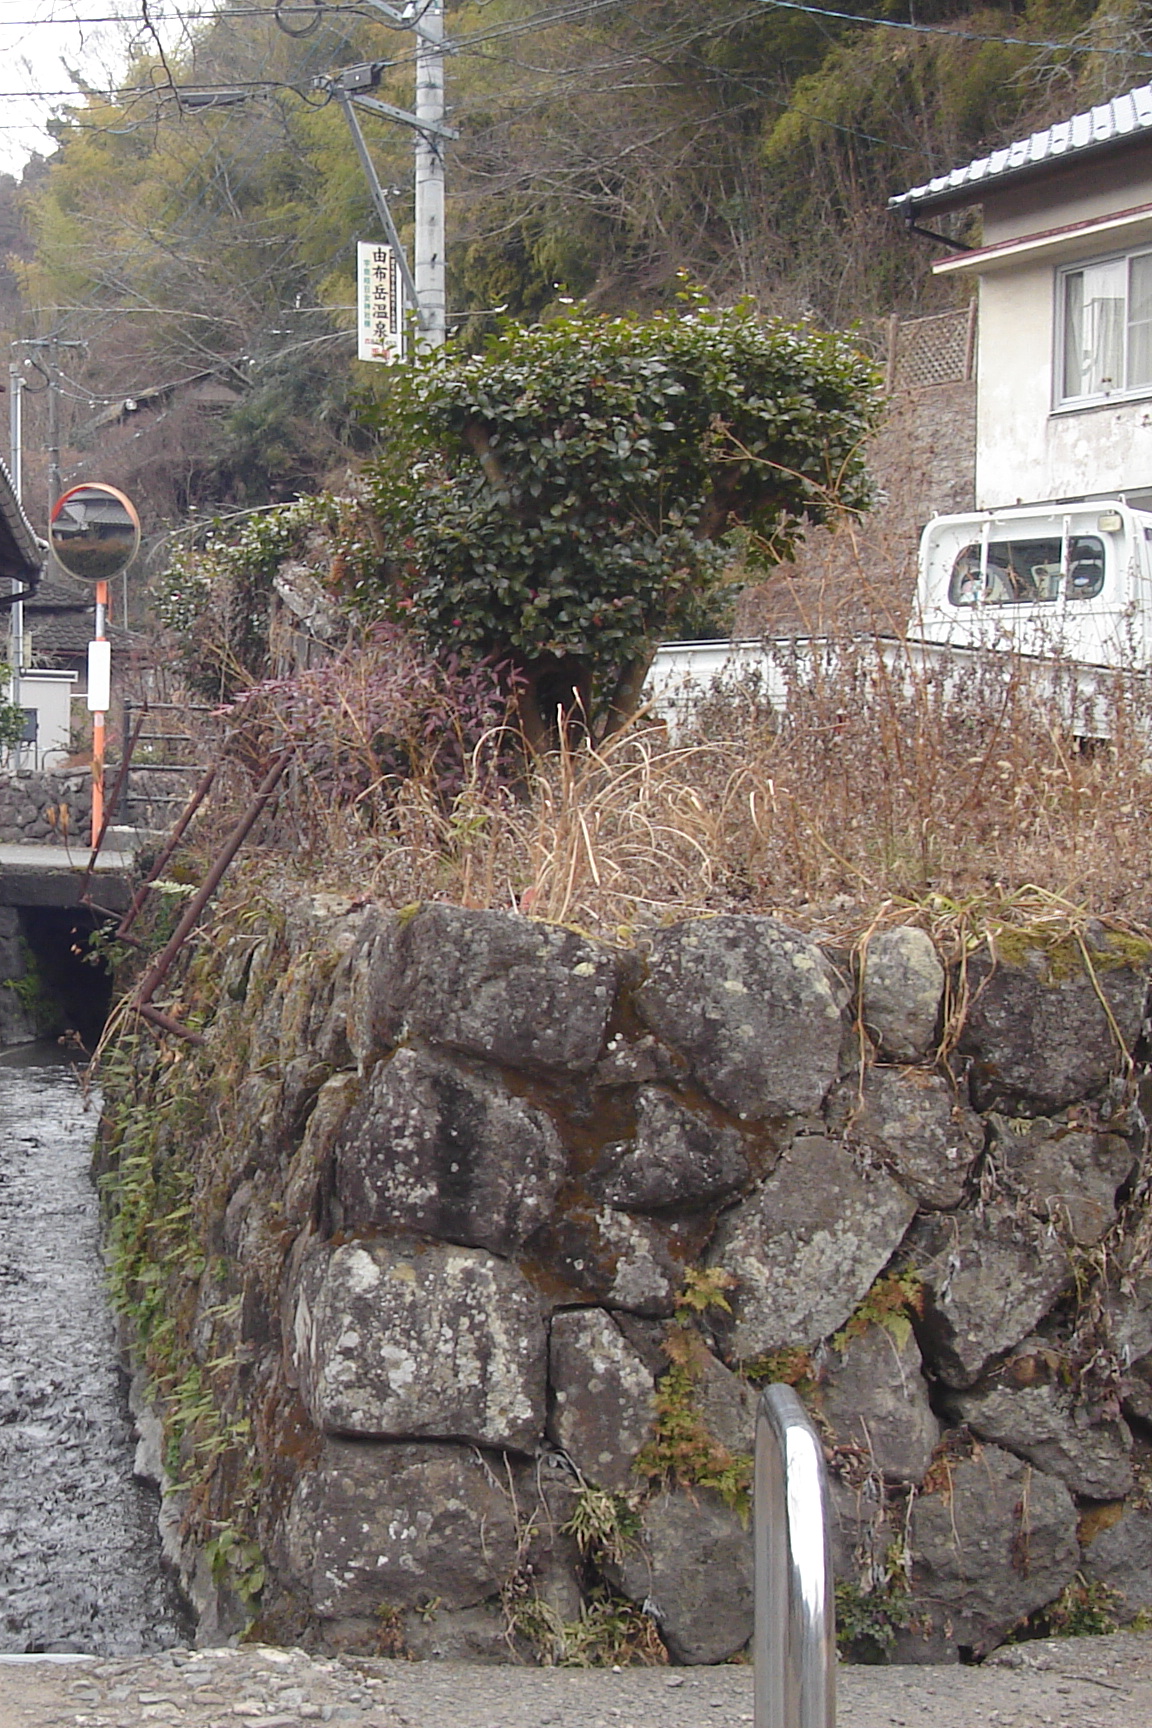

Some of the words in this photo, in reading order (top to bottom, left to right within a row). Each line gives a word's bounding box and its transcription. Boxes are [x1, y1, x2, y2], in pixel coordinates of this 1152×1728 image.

[372, 247, 389, 338] 由布岳温泉
